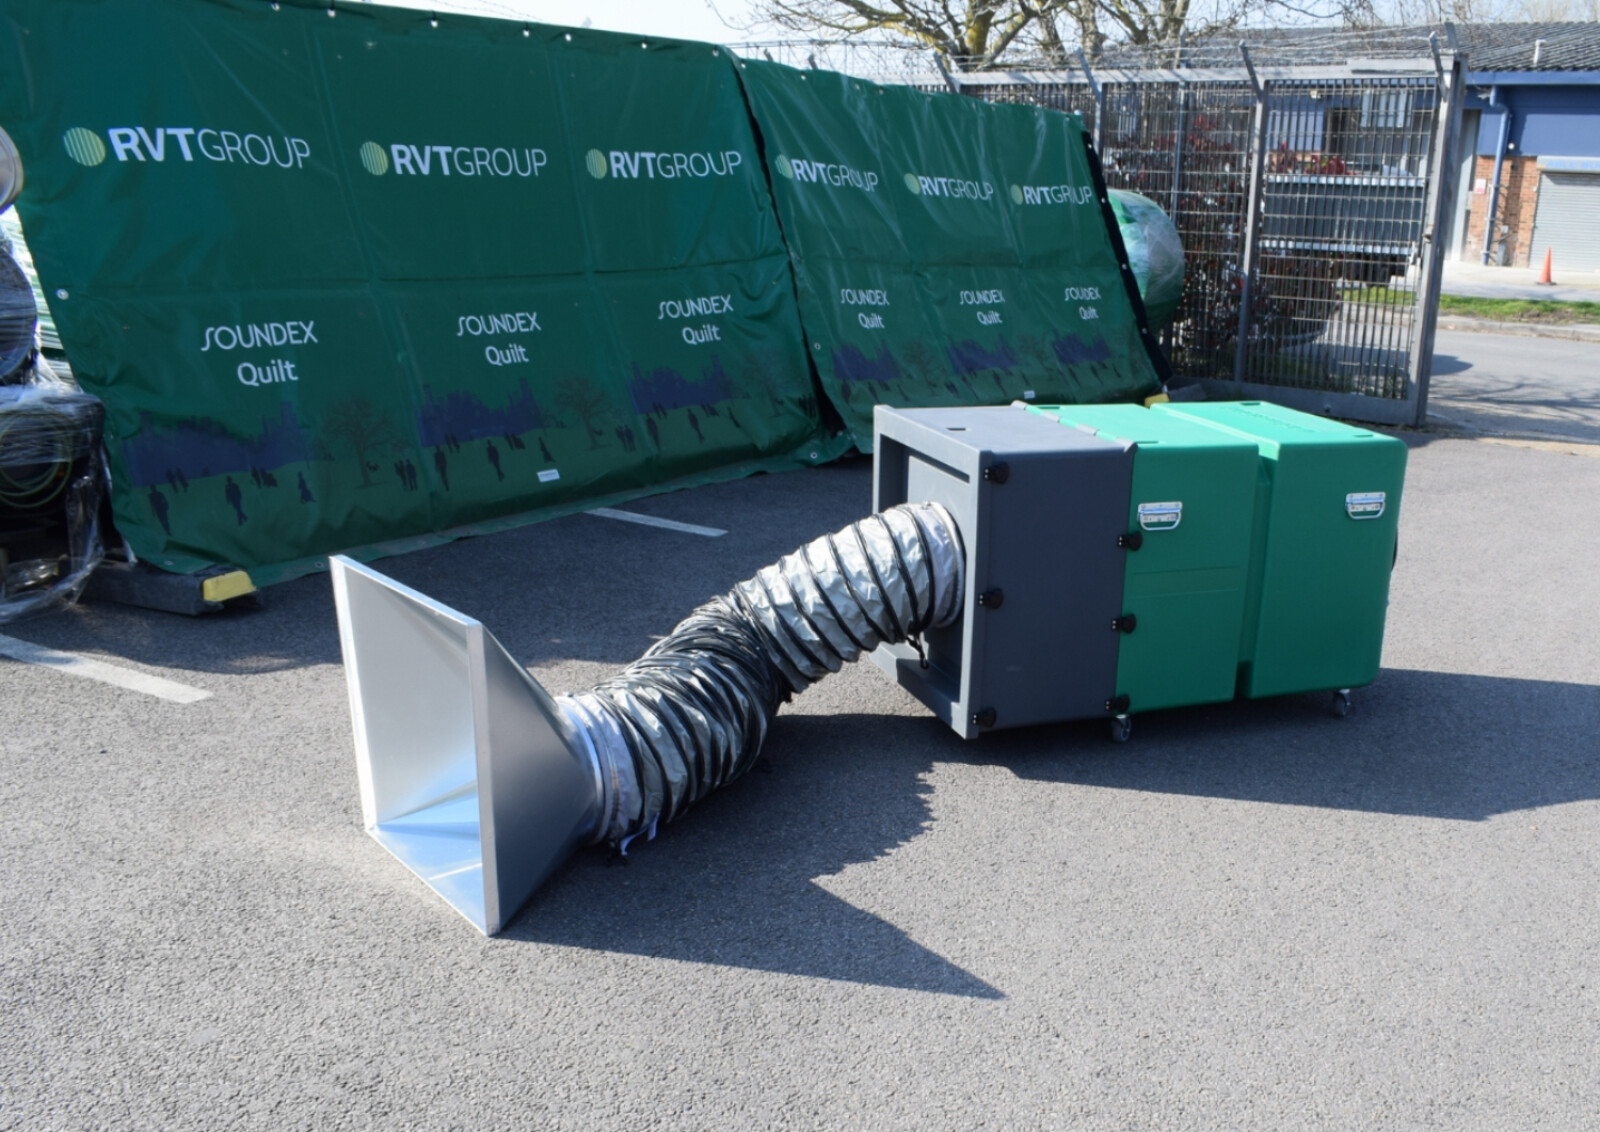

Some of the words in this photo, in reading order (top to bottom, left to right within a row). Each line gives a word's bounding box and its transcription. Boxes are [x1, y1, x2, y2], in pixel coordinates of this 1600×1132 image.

[107, 127, 311, 168] RVTGROUP
[391, 144, 548, 177] RVTGROUP
[610, 150, 742, 179] RVTGROUP
[658, 294, 733, 320] SOUNDEX
[841, 288, 890, 306] SOUNDEX
[960, 289, 1005, 305] SOUNDEX
[456, 312, 541, 337] SOUNDEX
[858, 312, 885, 329] Quilt
[201, 320, 318, 351] SOUNDEX
[682, 324, 721, 346] Quilt
[485, 344, 529, 367] Quilt
[237, 359, 298, 386] Quilt
